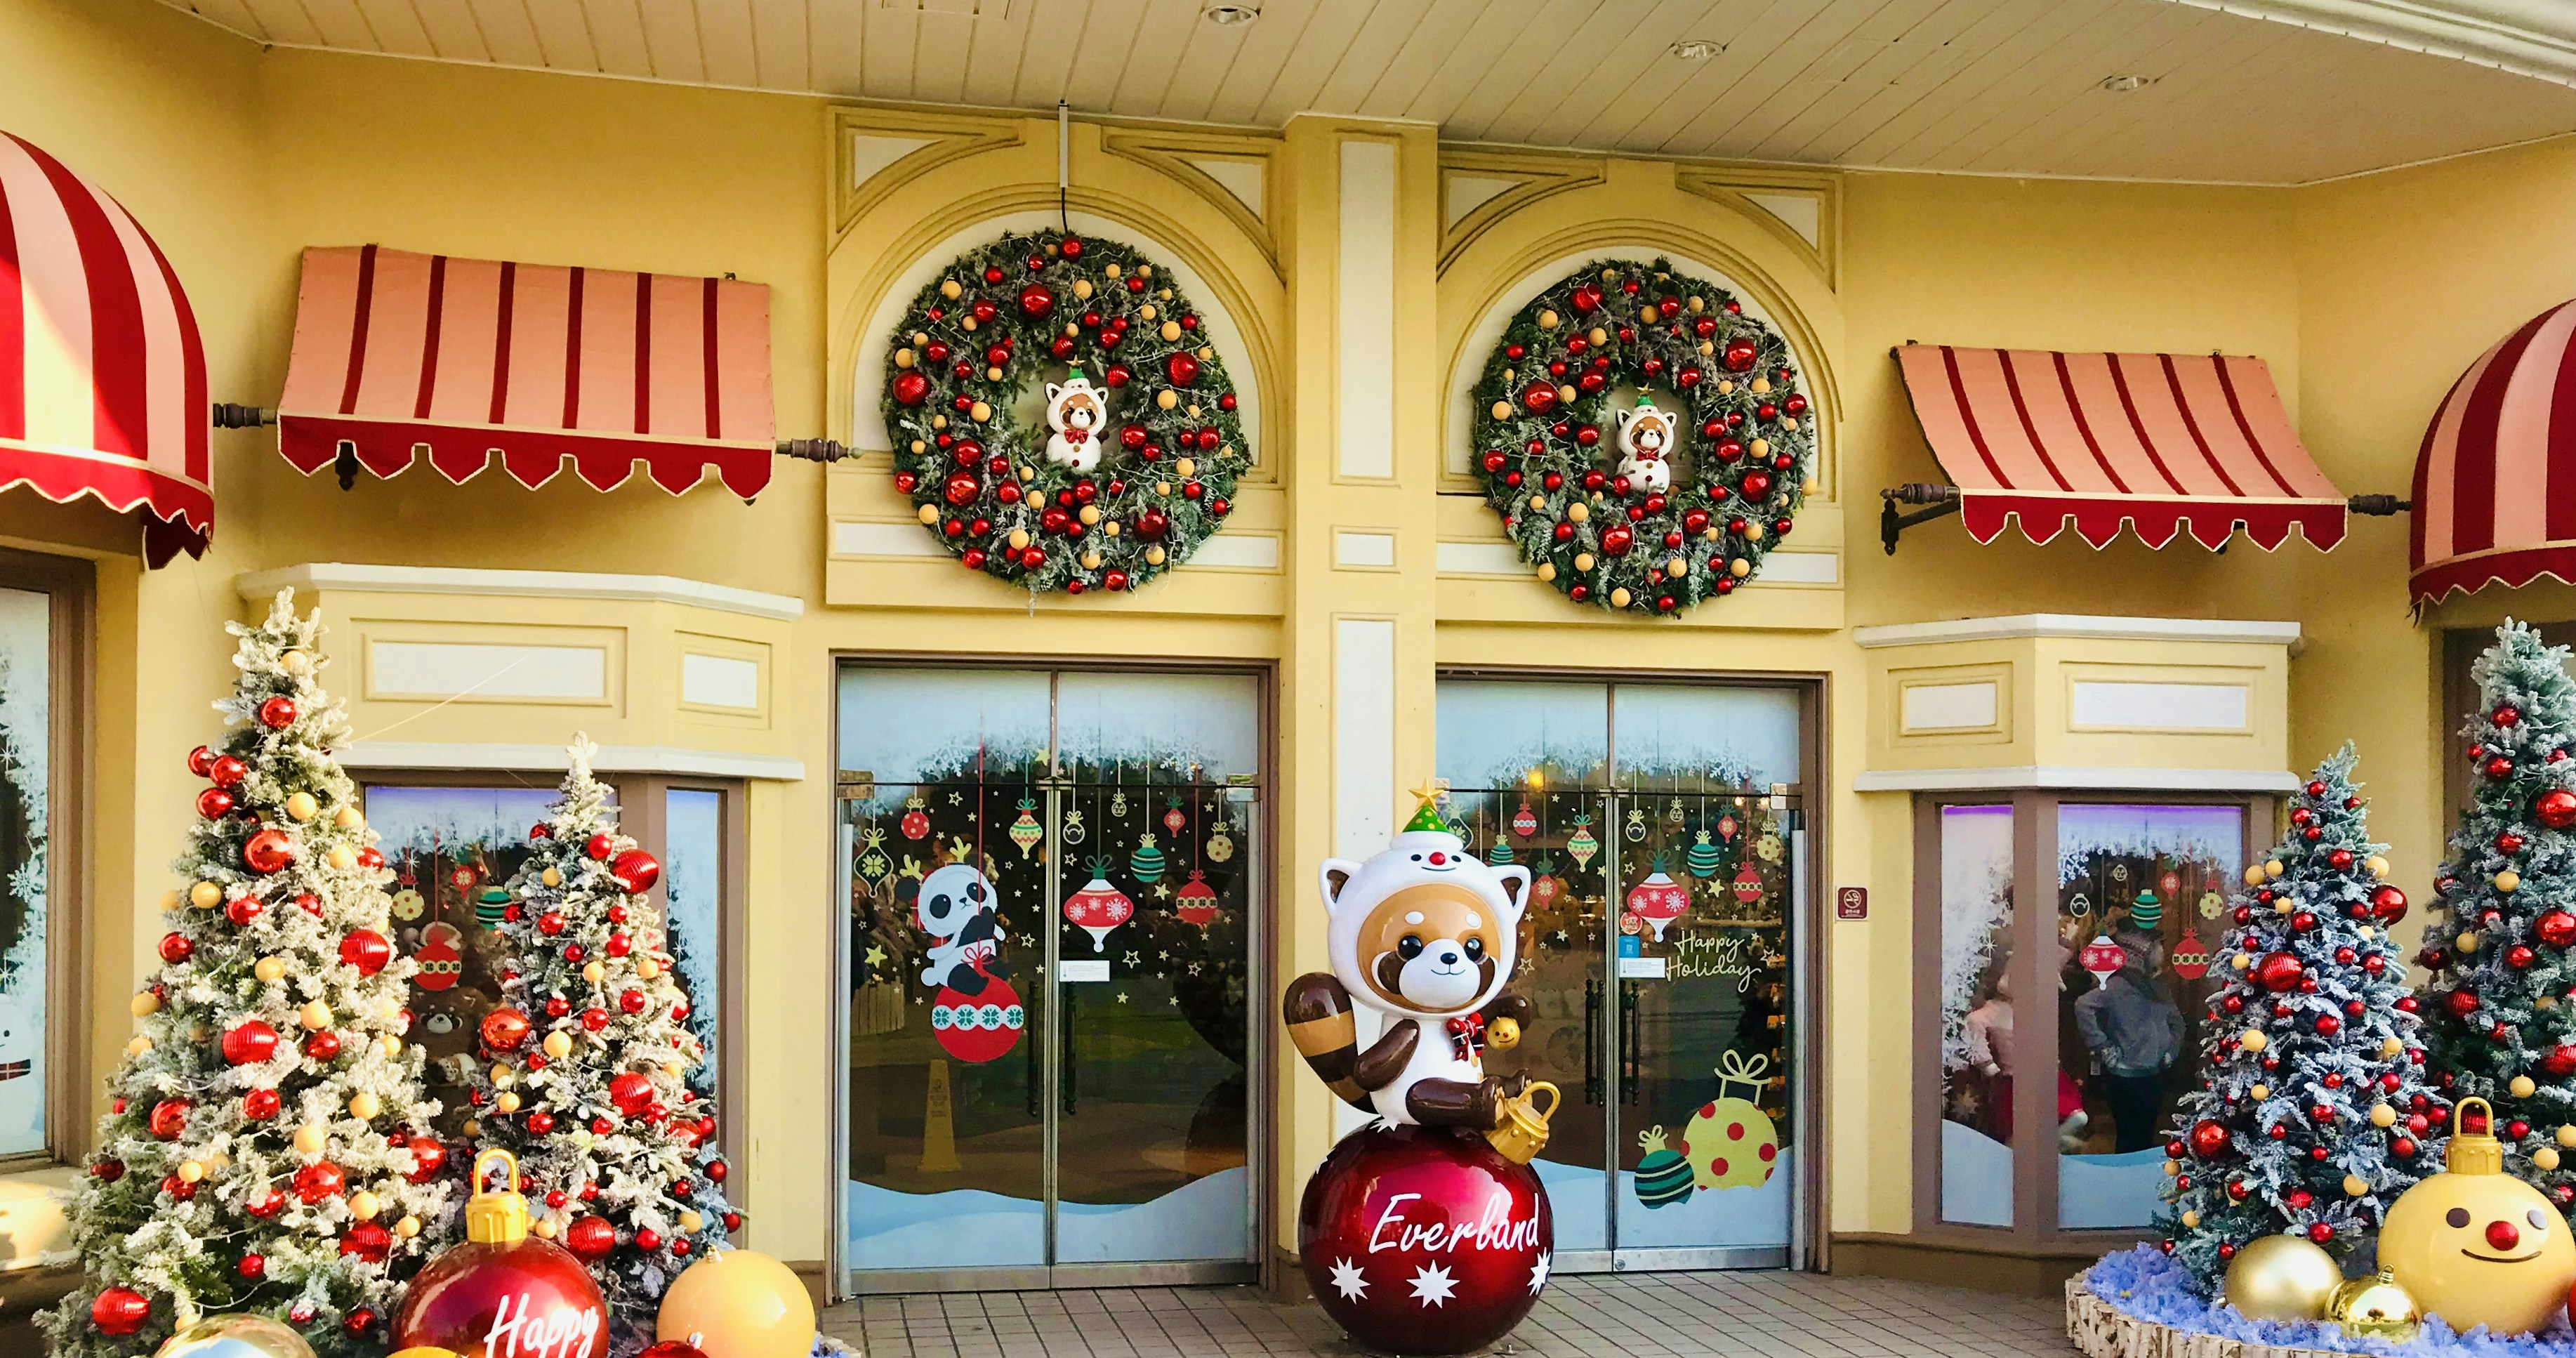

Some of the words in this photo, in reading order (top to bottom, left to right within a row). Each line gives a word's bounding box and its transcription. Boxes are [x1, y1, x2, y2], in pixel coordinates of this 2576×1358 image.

[1674, 929, 1745, 963] Happy
[1666, 954, 1762, 993] Holiday
[1368, 1193, 1539, 1254] Everland
[484, 1292, 599, 1358] Happy
